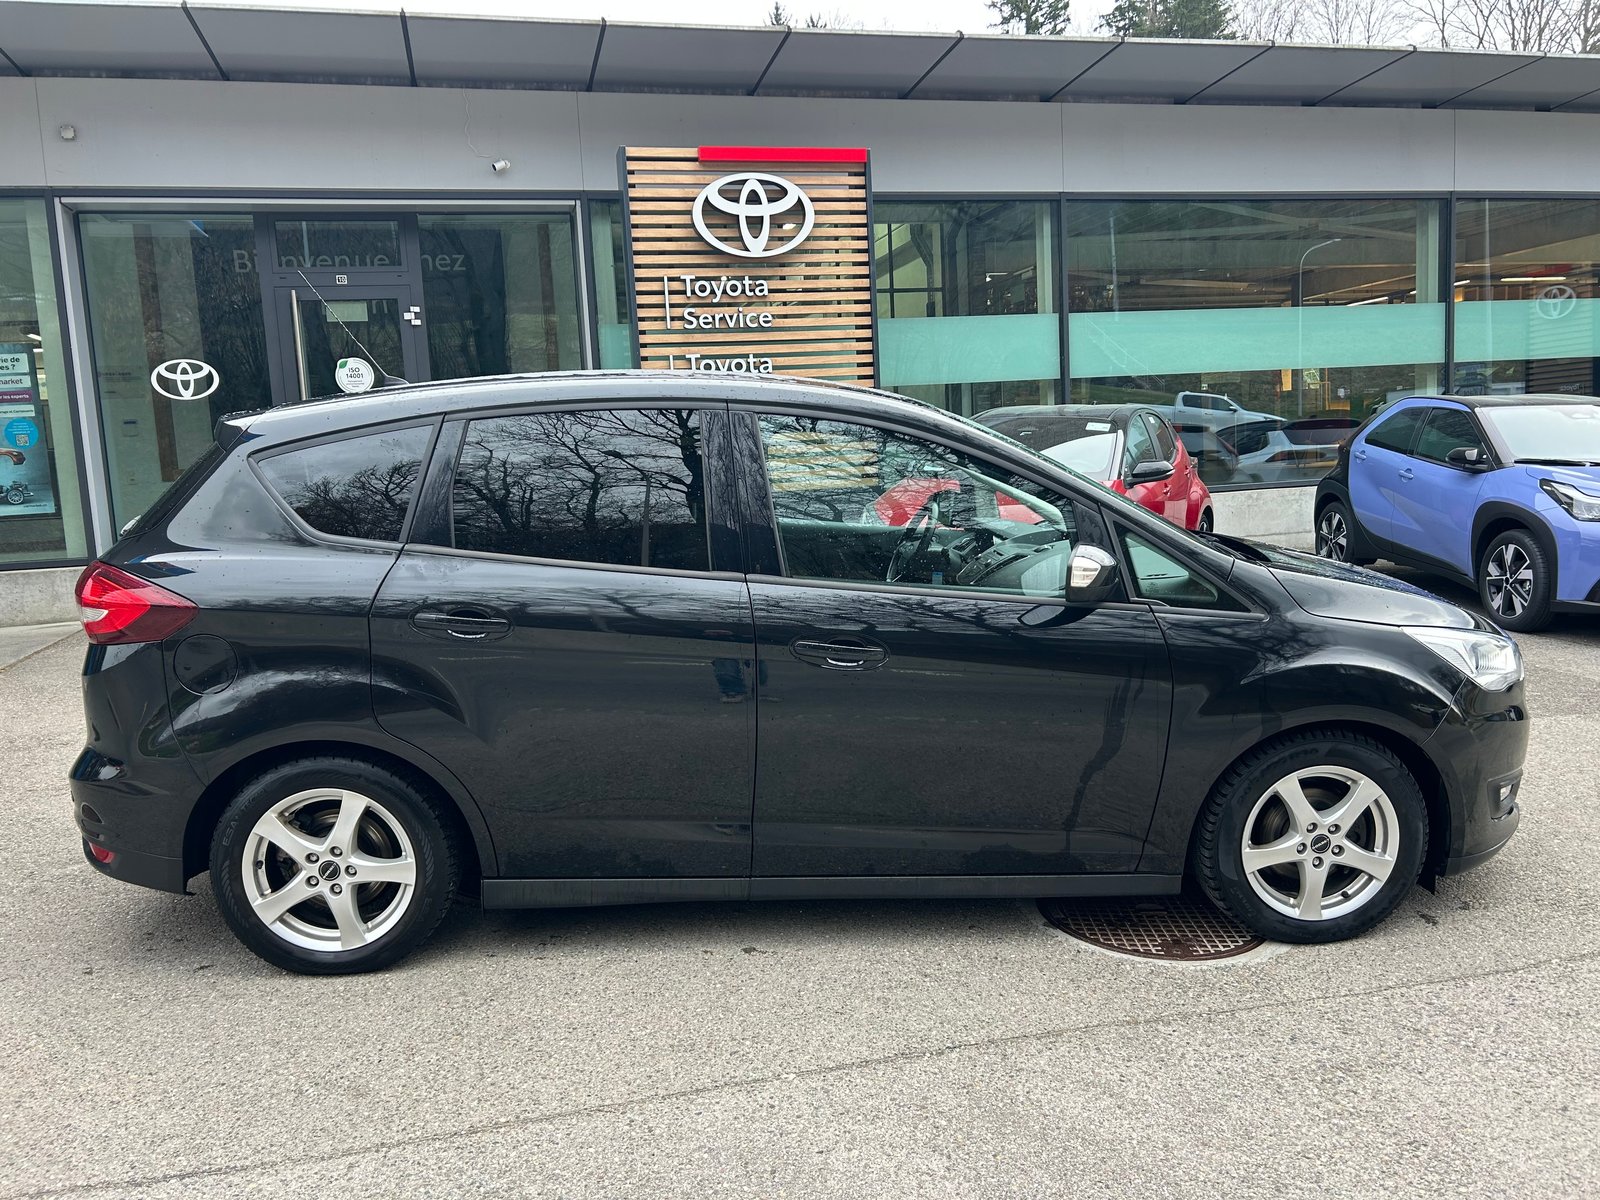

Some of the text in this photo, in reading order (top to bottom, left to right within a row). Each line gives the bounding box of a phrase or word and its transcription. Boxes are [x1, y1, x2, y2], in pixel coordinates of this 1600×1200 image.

[232, 249, 390, 273] Binvenue
[680, 275, 769, 303] Toyota
[683, 307, 773, 329] Service
[685, 353, 773, 373] Toyota
